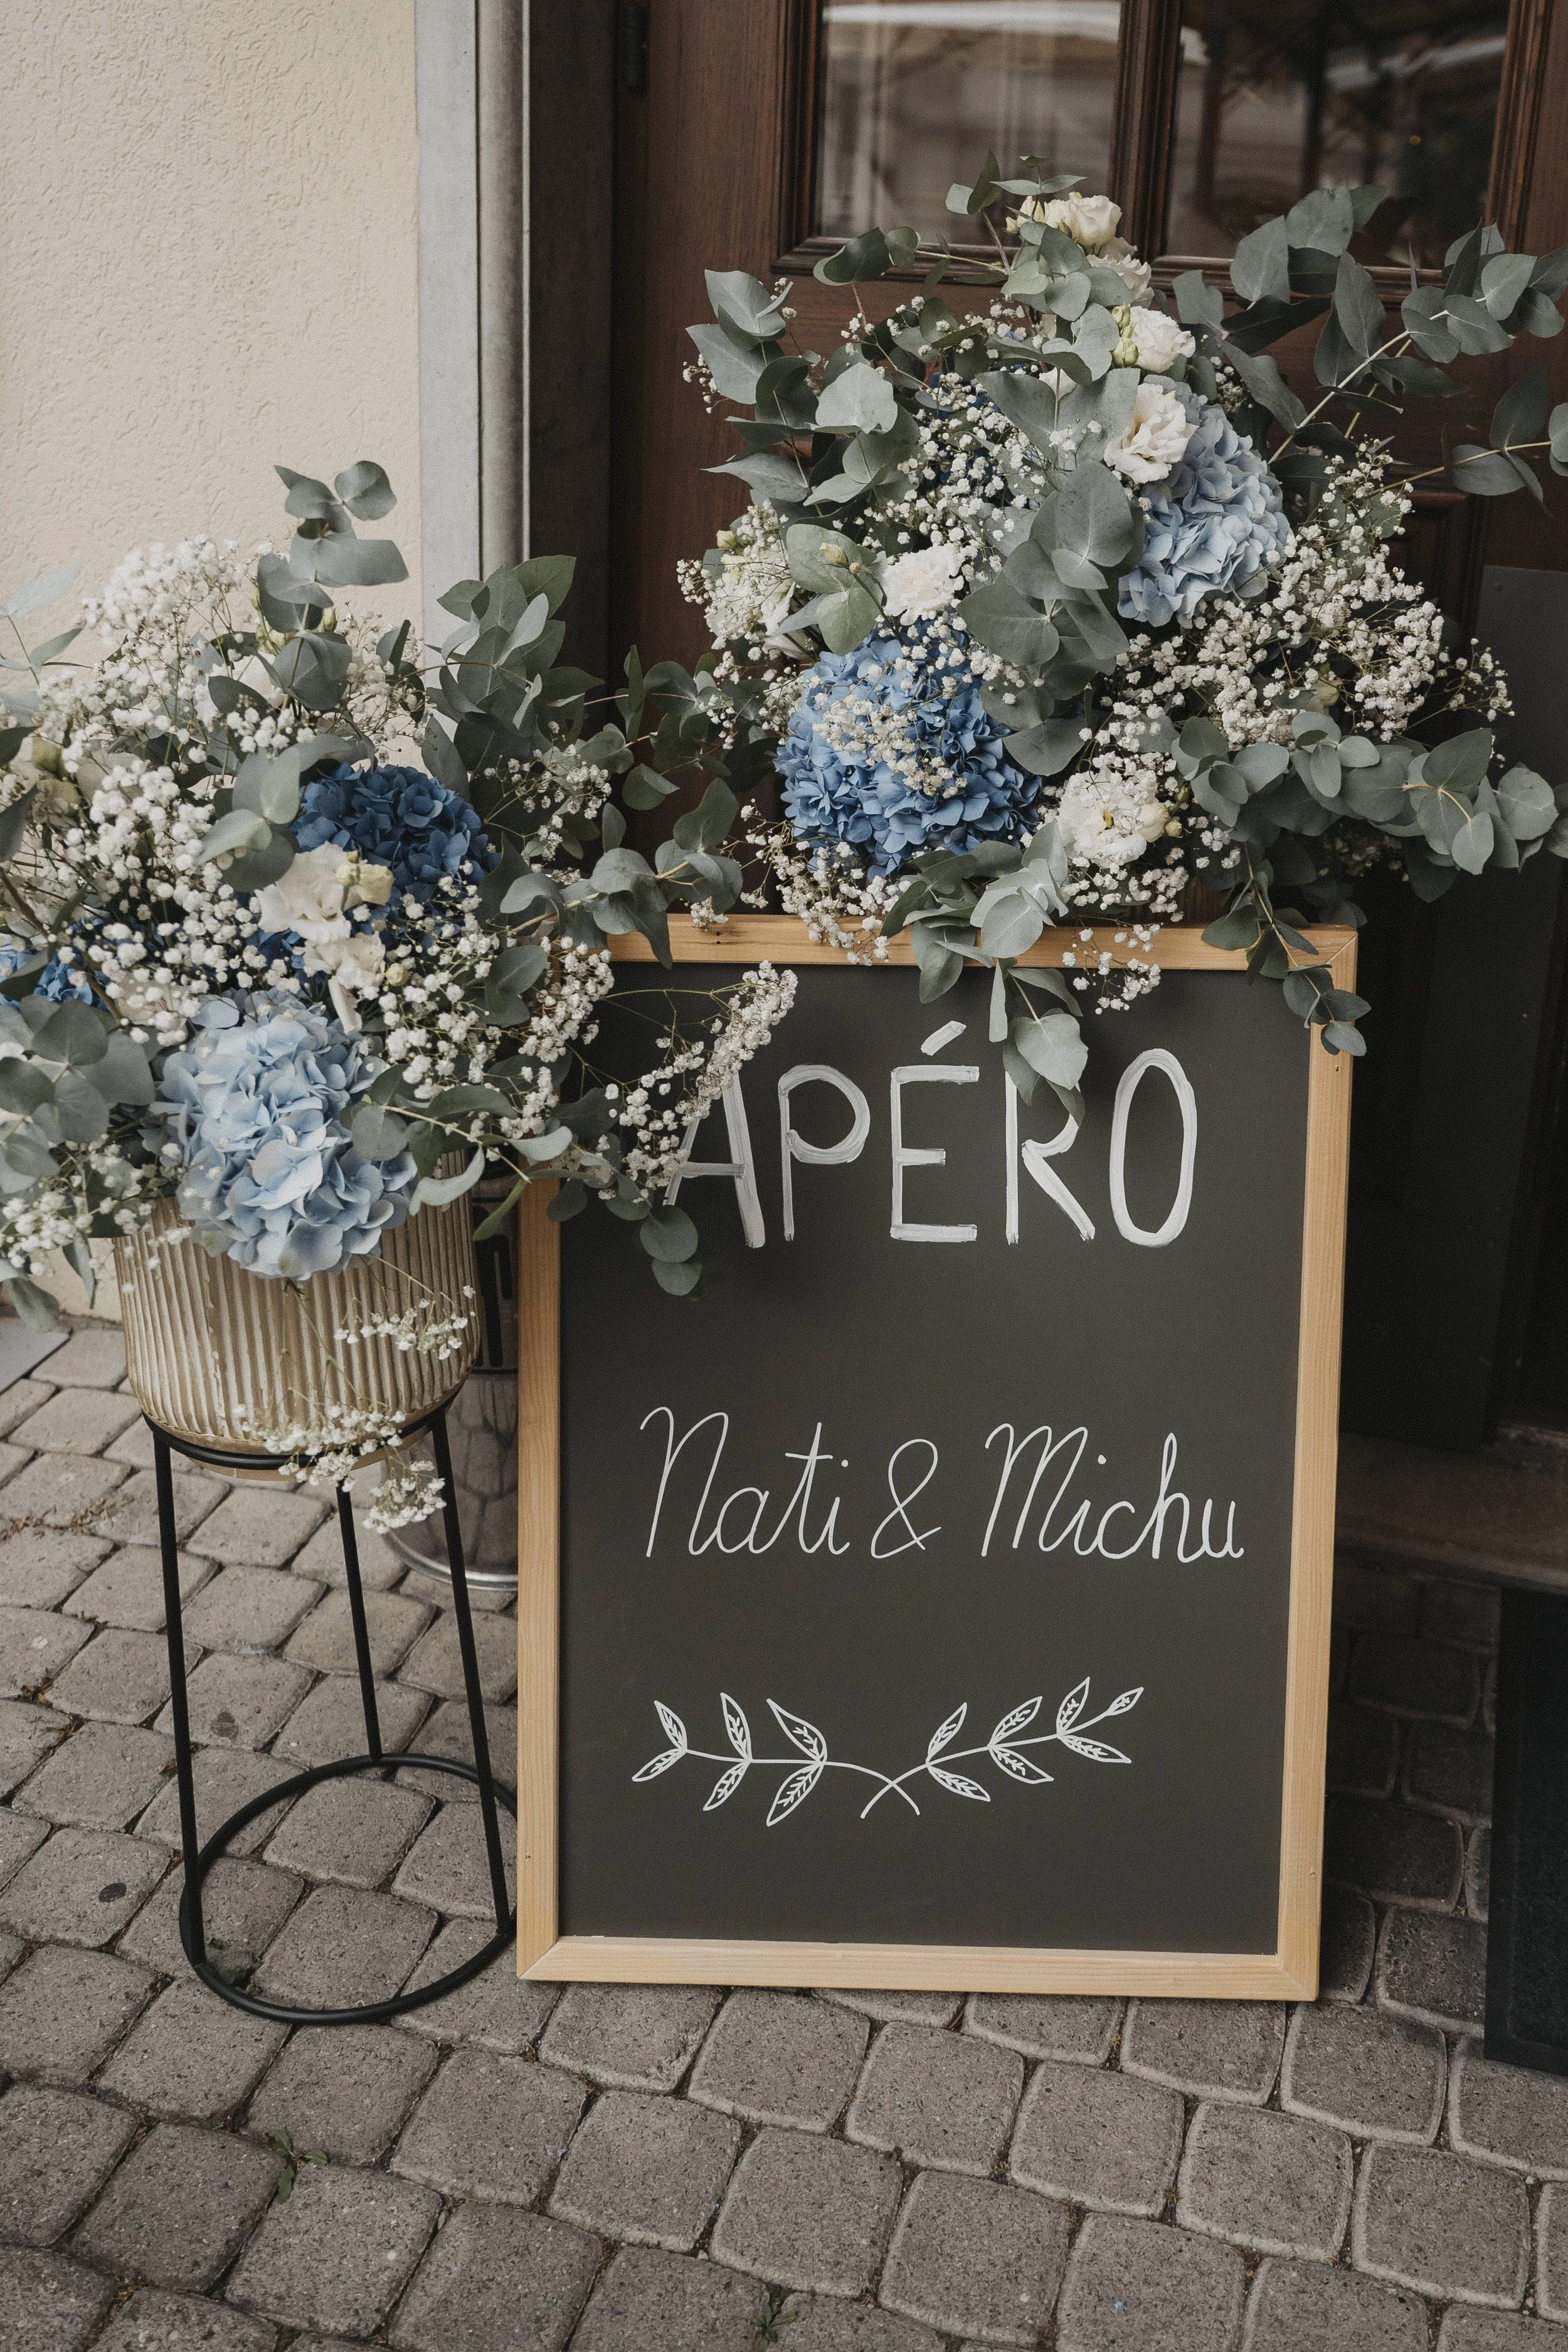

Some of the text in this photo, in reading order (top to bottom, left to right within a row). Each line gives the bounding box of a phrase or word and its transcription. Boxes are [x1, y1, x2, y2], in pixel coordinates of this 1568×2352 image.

[663, 1020, 1197, 1248] APÉRO
[640, 1406, 1244, 1564] Nati & Michu
